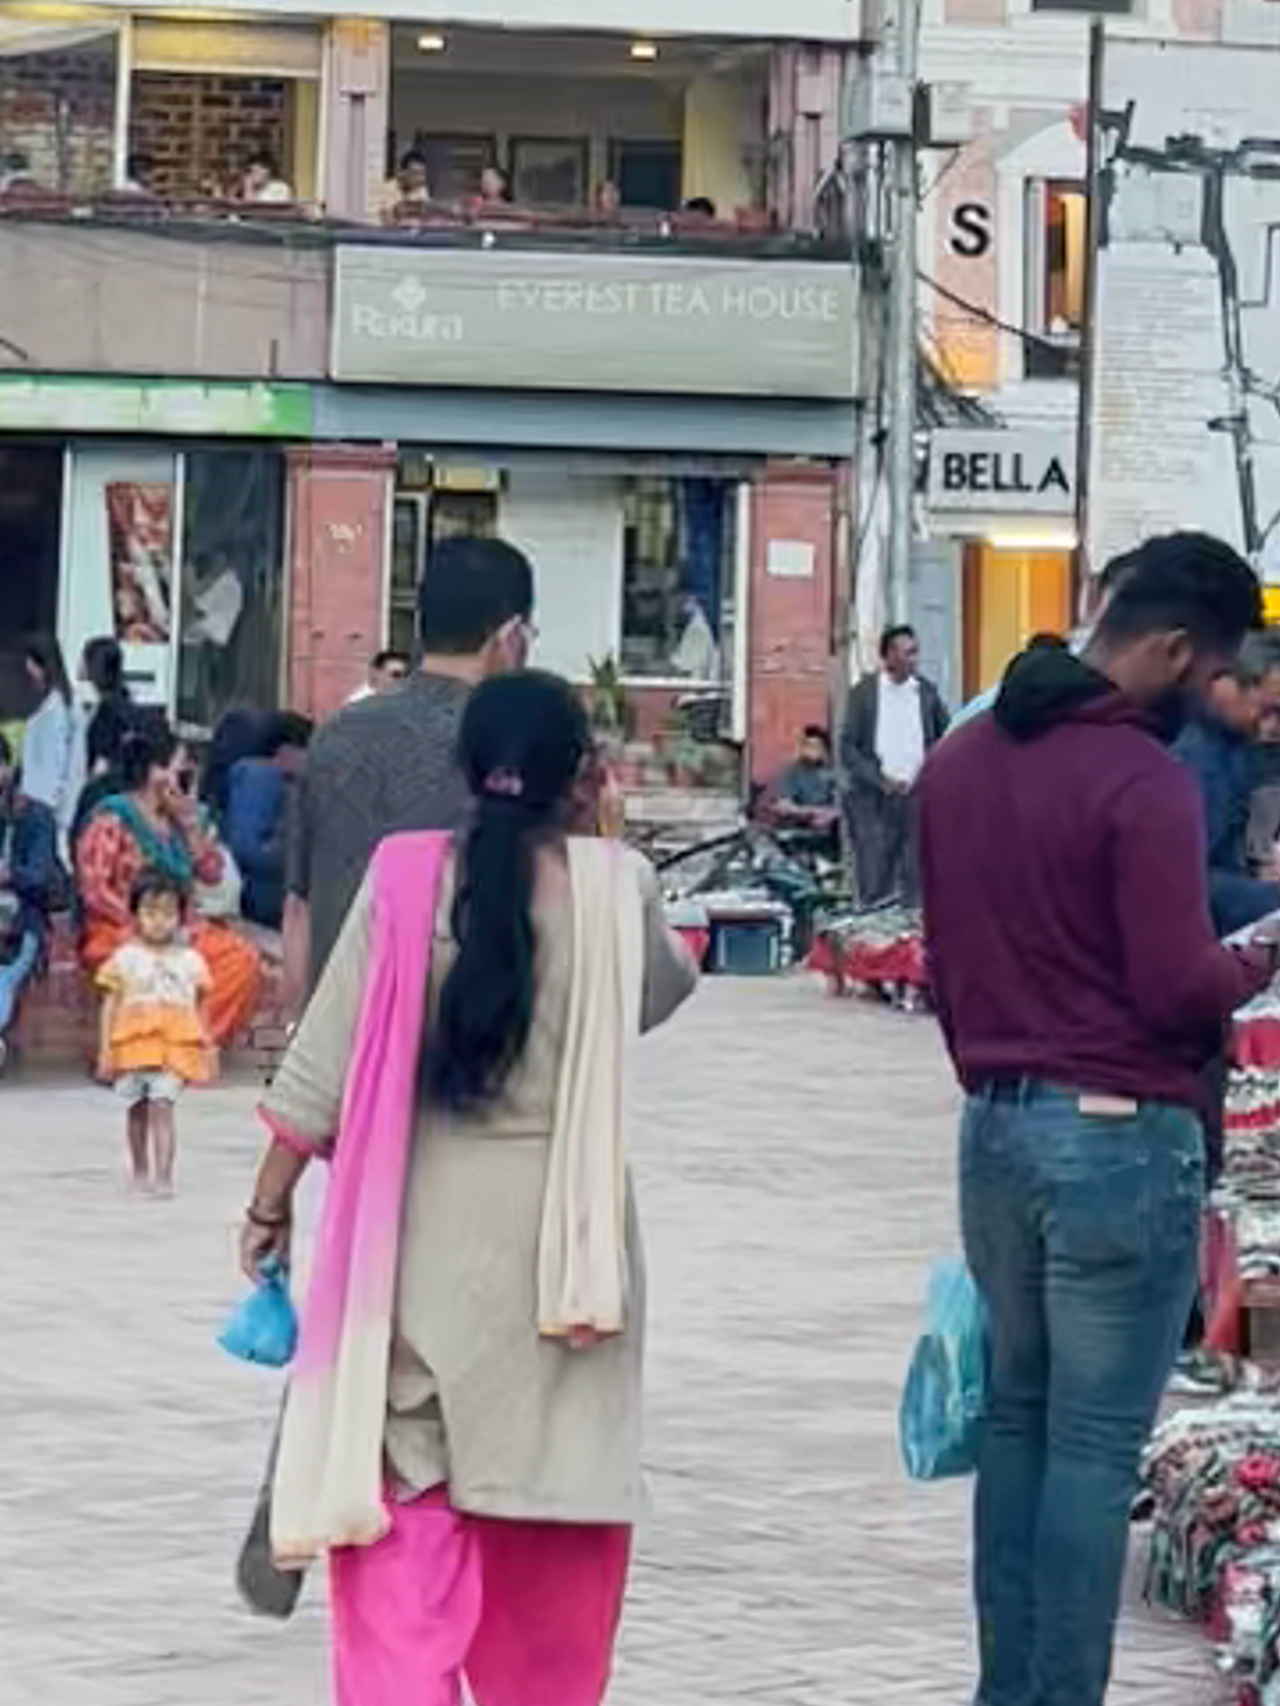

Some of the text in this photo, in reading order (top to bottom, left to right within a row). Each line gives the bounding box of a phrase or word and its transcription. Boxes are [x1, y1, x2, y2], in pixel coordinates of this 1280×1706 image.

[496, 280, 840, 322] EVEREST TEA HOUSE
[942, 452, 1070, 494] BELLA
